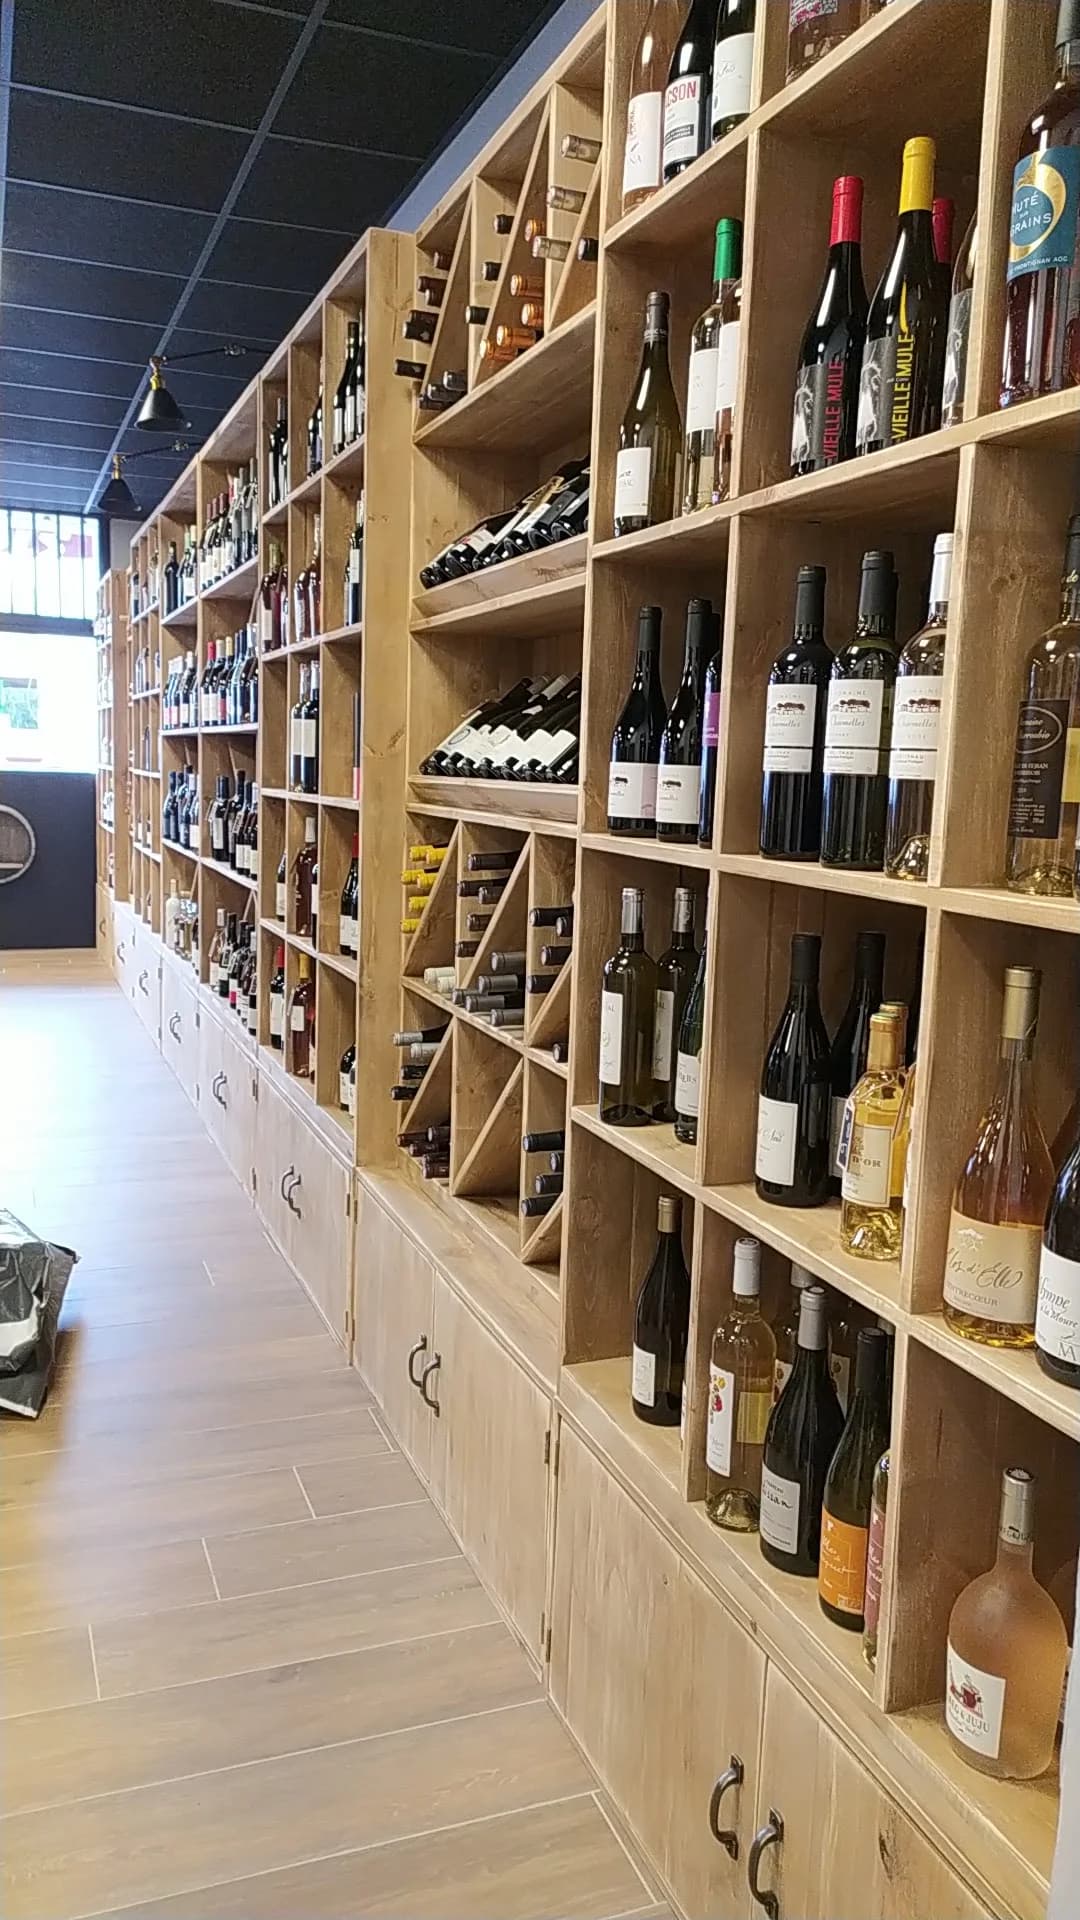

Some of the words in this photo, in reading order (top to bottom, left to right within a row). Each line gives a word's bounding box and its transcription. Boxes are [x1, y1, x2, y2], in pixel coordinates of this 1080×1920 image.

[896, 334, 914, 376] MULE
[828, 360, 845, 401] MULE
[824, 405, 842, 460] VIEILLE
[892, 382, 911, 440] VIEILLE
